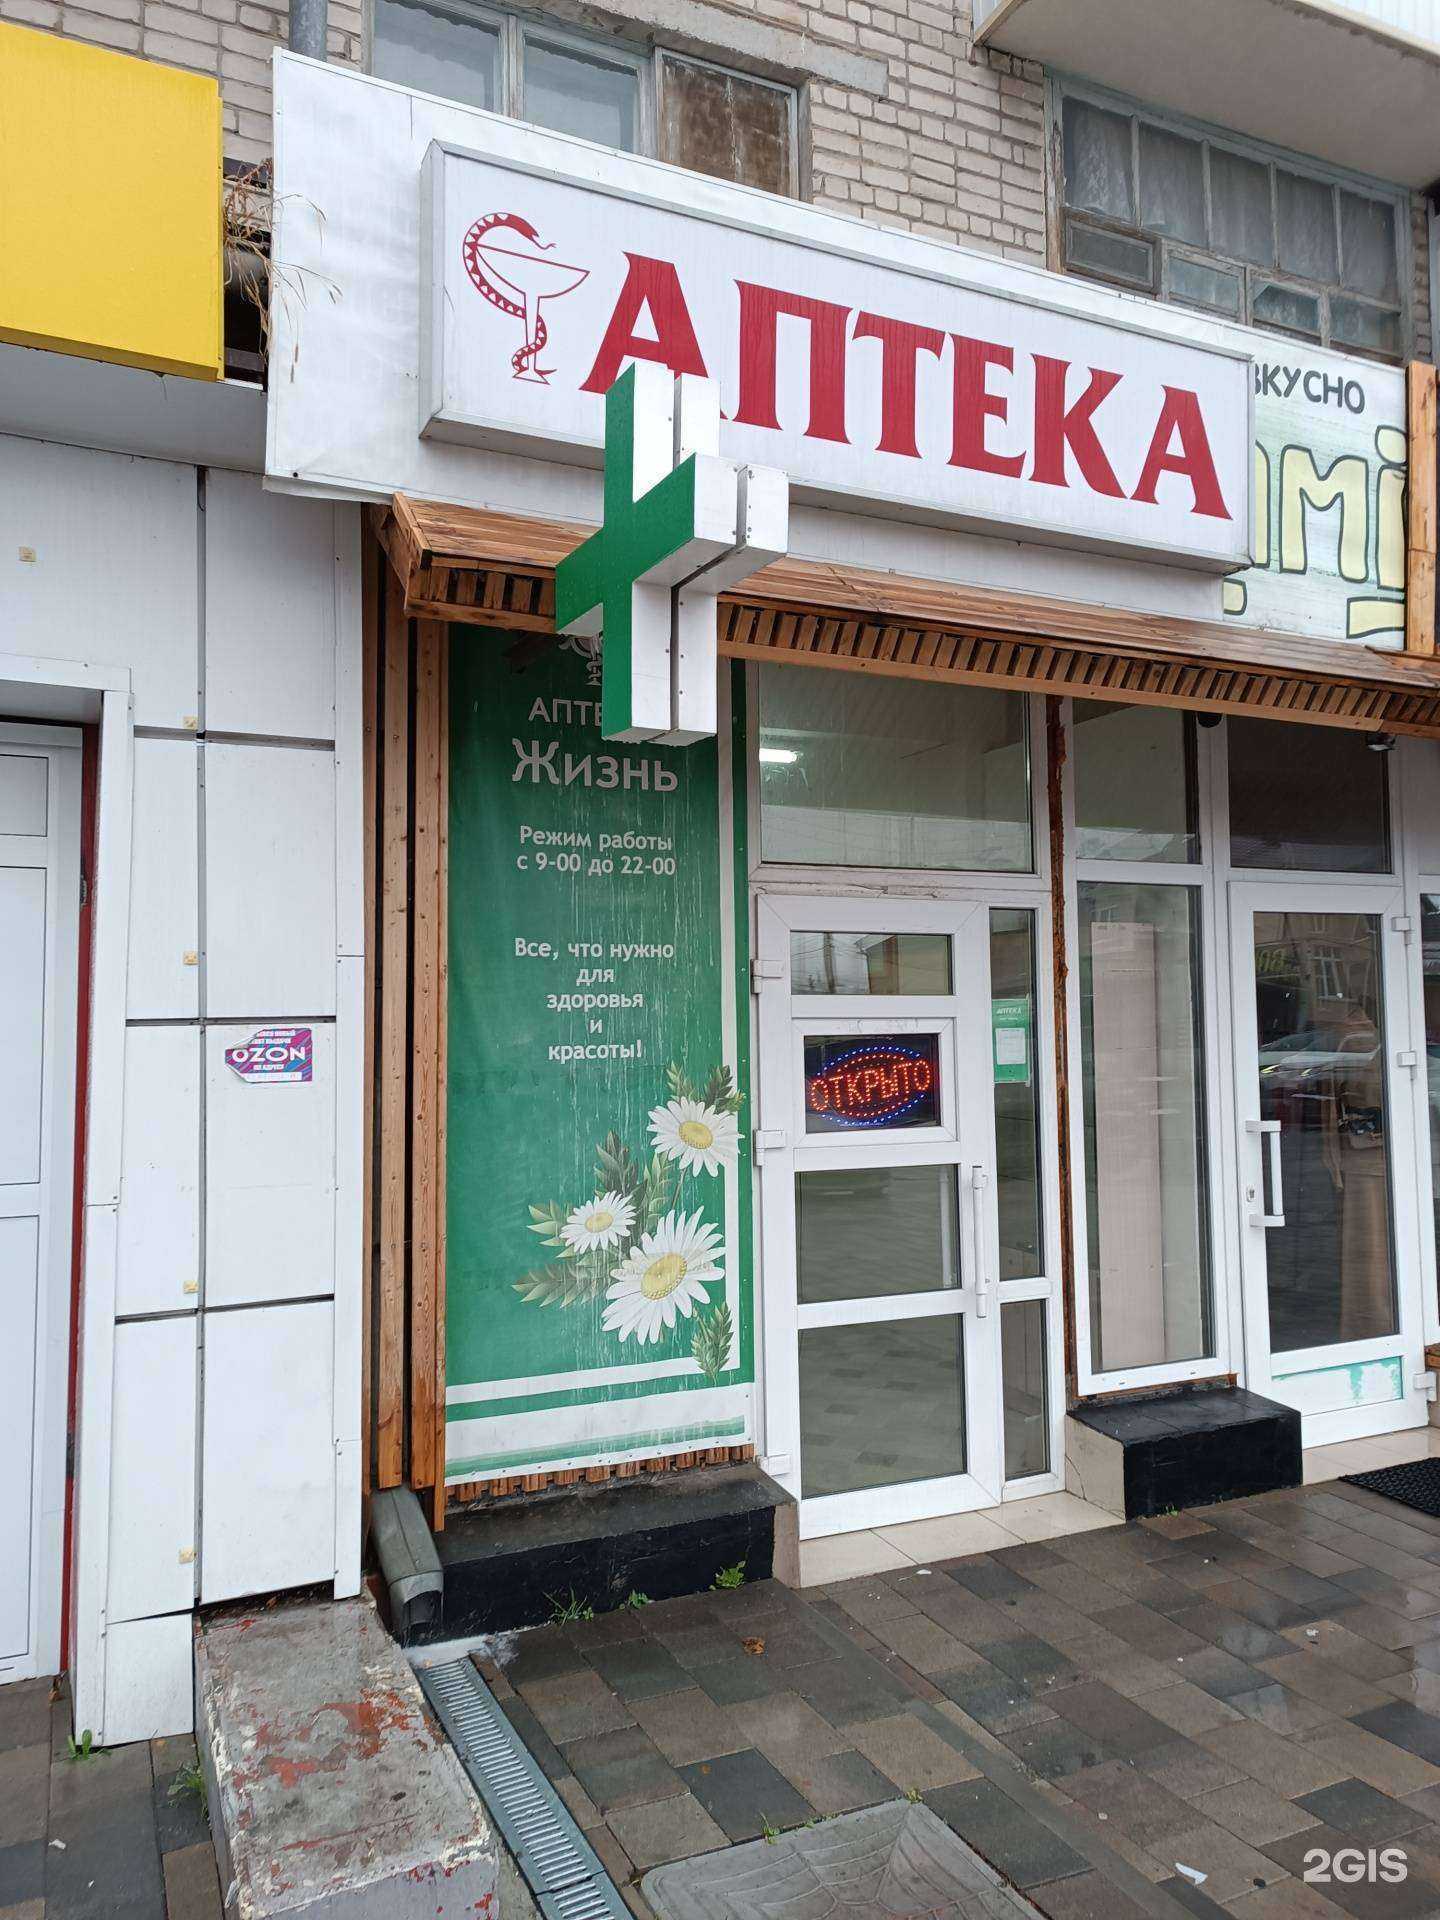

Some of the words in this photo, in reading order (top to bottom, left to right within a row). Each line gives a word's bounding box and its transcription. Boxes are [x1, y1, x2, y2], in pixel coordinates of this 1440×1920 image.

[578, 251, 1234, 521] АПТЕКА
[519, 825, 592, 848] Режим
[599, 831, 673, 852] работы
[516, 855, 528, 870] с
[535, 852, 582, 873] 9-00
[588, 858, 614, 876] до
[620, 855, 676, 876] 22-00
[514, 937, 559, 960] Все,
[567, 943, 603, 958] что
[610, 943, 674, 962] нужно
[576, 968, 615, 986] для
[546, 993, 644, 1012] здоровья
[589, 1018, 603, 1034] и
[231, 1046, 306, 1063] OZON
[548, 1039, 643, 1064] красоты!
[810, 1059, 932, 1112] ОТКРЫТО
